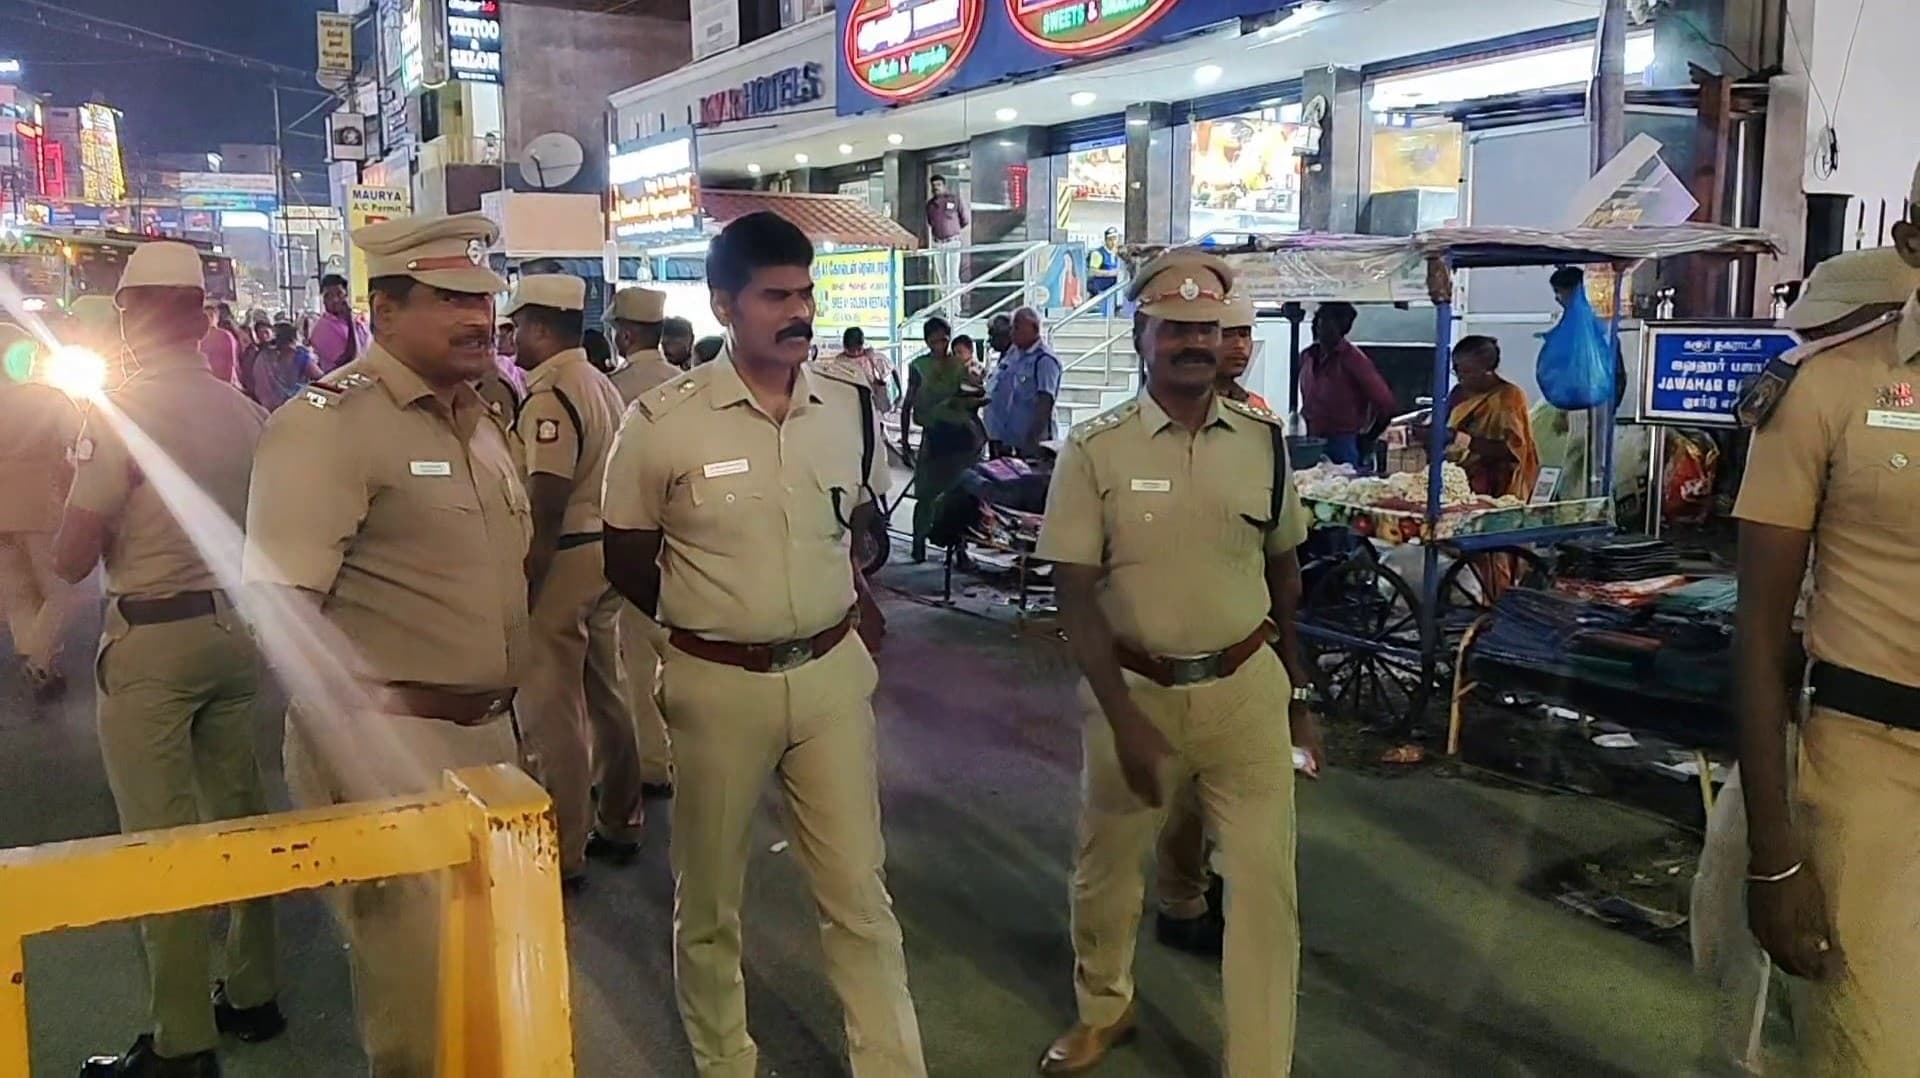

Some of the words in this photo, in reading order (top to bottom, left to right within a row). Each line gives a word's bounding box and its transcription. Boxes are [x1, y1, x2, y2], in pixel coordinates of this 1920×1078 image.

[1043, 3, 1085, 33] SWEETS
[1087, 1, 1097, 21] &
[448, 16, 500, 39] TATTOO
[743, 61, 824, 116] HOTELS
[352, 190, 402, 201] MAURYA
[371, 204, 402, 212] Permit
[1657, 376, 1723, 391] JAWAHAR
